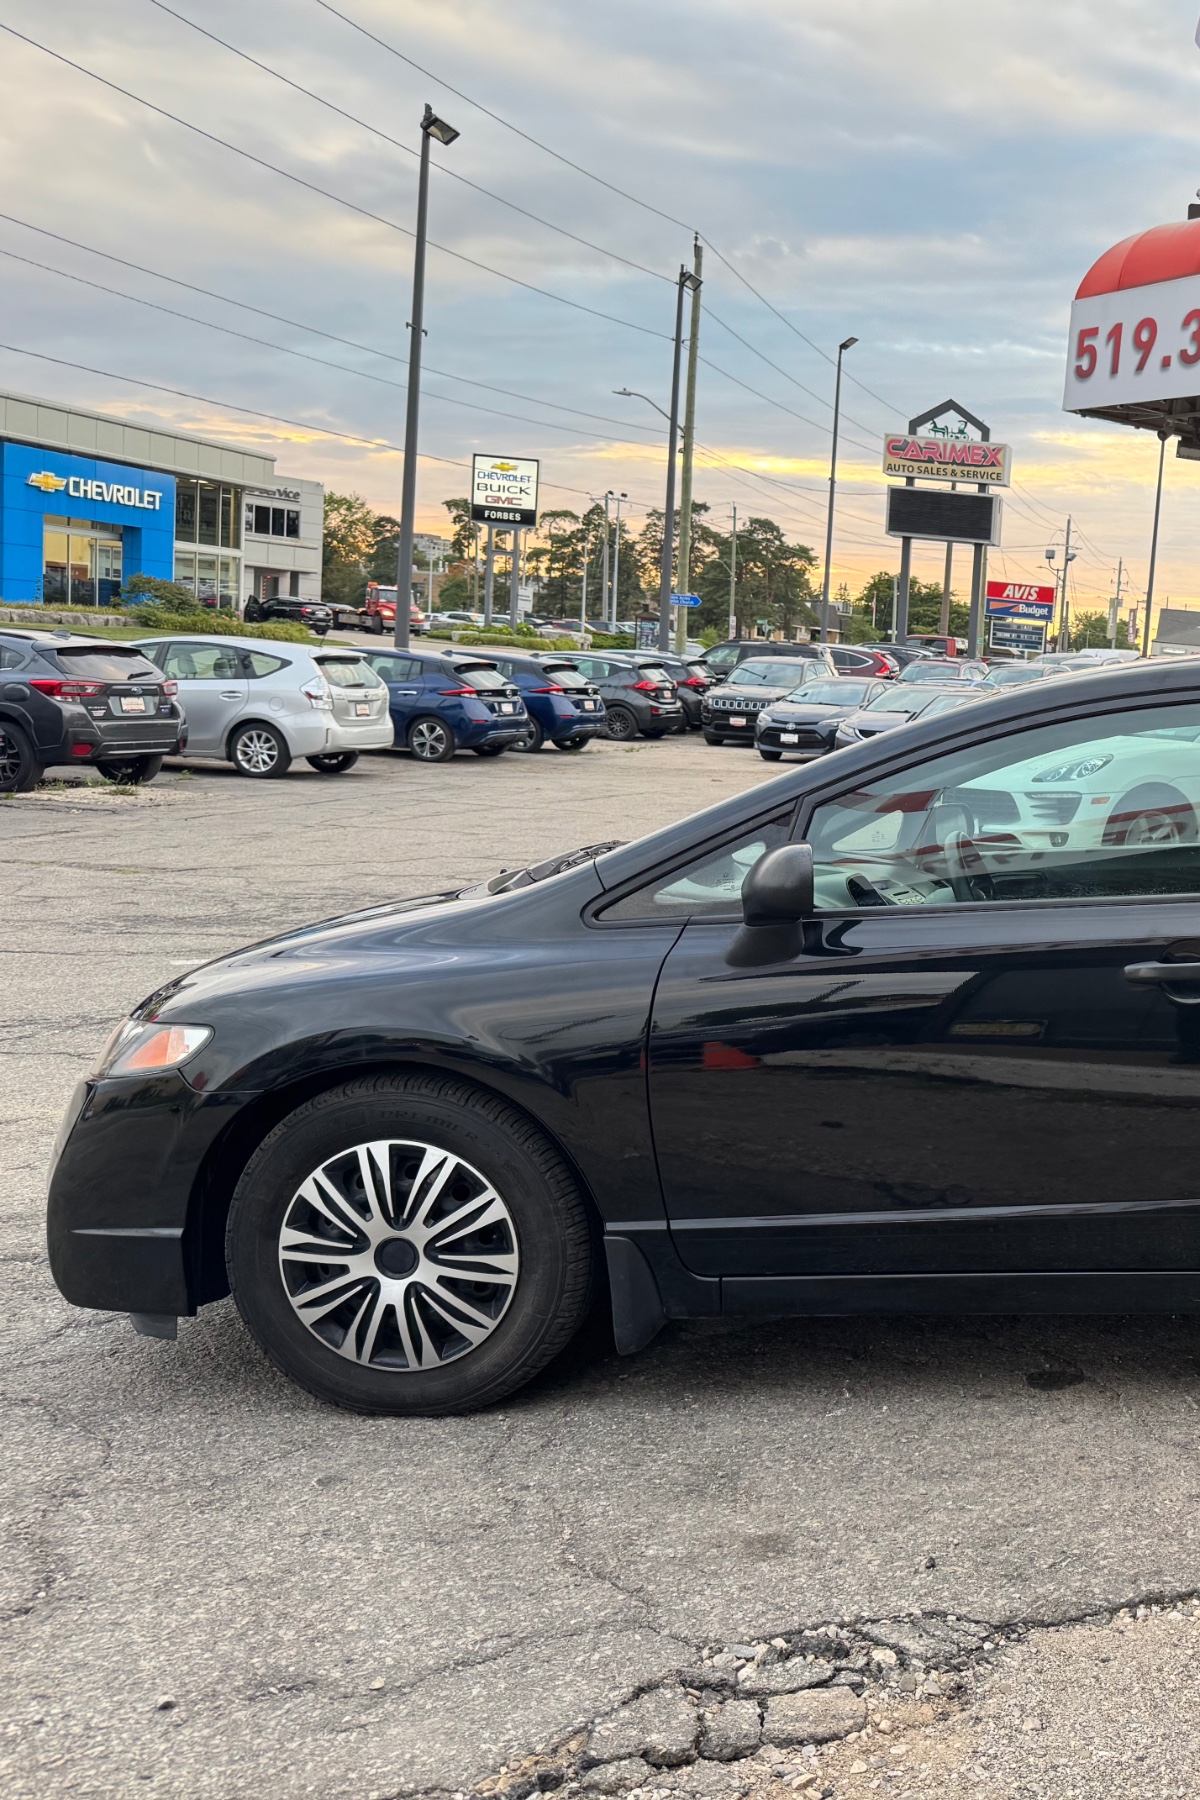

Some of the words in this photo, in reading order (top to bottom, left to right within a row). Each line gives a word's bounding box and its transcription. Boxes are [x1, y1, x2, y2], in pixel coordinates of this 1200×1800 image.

[886, 438, 1005, 467] CARIMEX
[477, 471, 533, 484] CHEVROLET
[886, 463, 915, 473] AUTO
[917, 465, 948, 477] SALES
[950, 468, 958, 477] &
[960, 469, 1003, 481] SERVICE
[68, 476, 163, 510] CHEVROLET
[477, 482, 532, 496] BUICK
[485, 495, 523, 507] GMC
[484, 510, 522, 522] FORBES
[1002, 584, 1040, 601] AVIS
[1019, 604, 1049, 617] Budget
